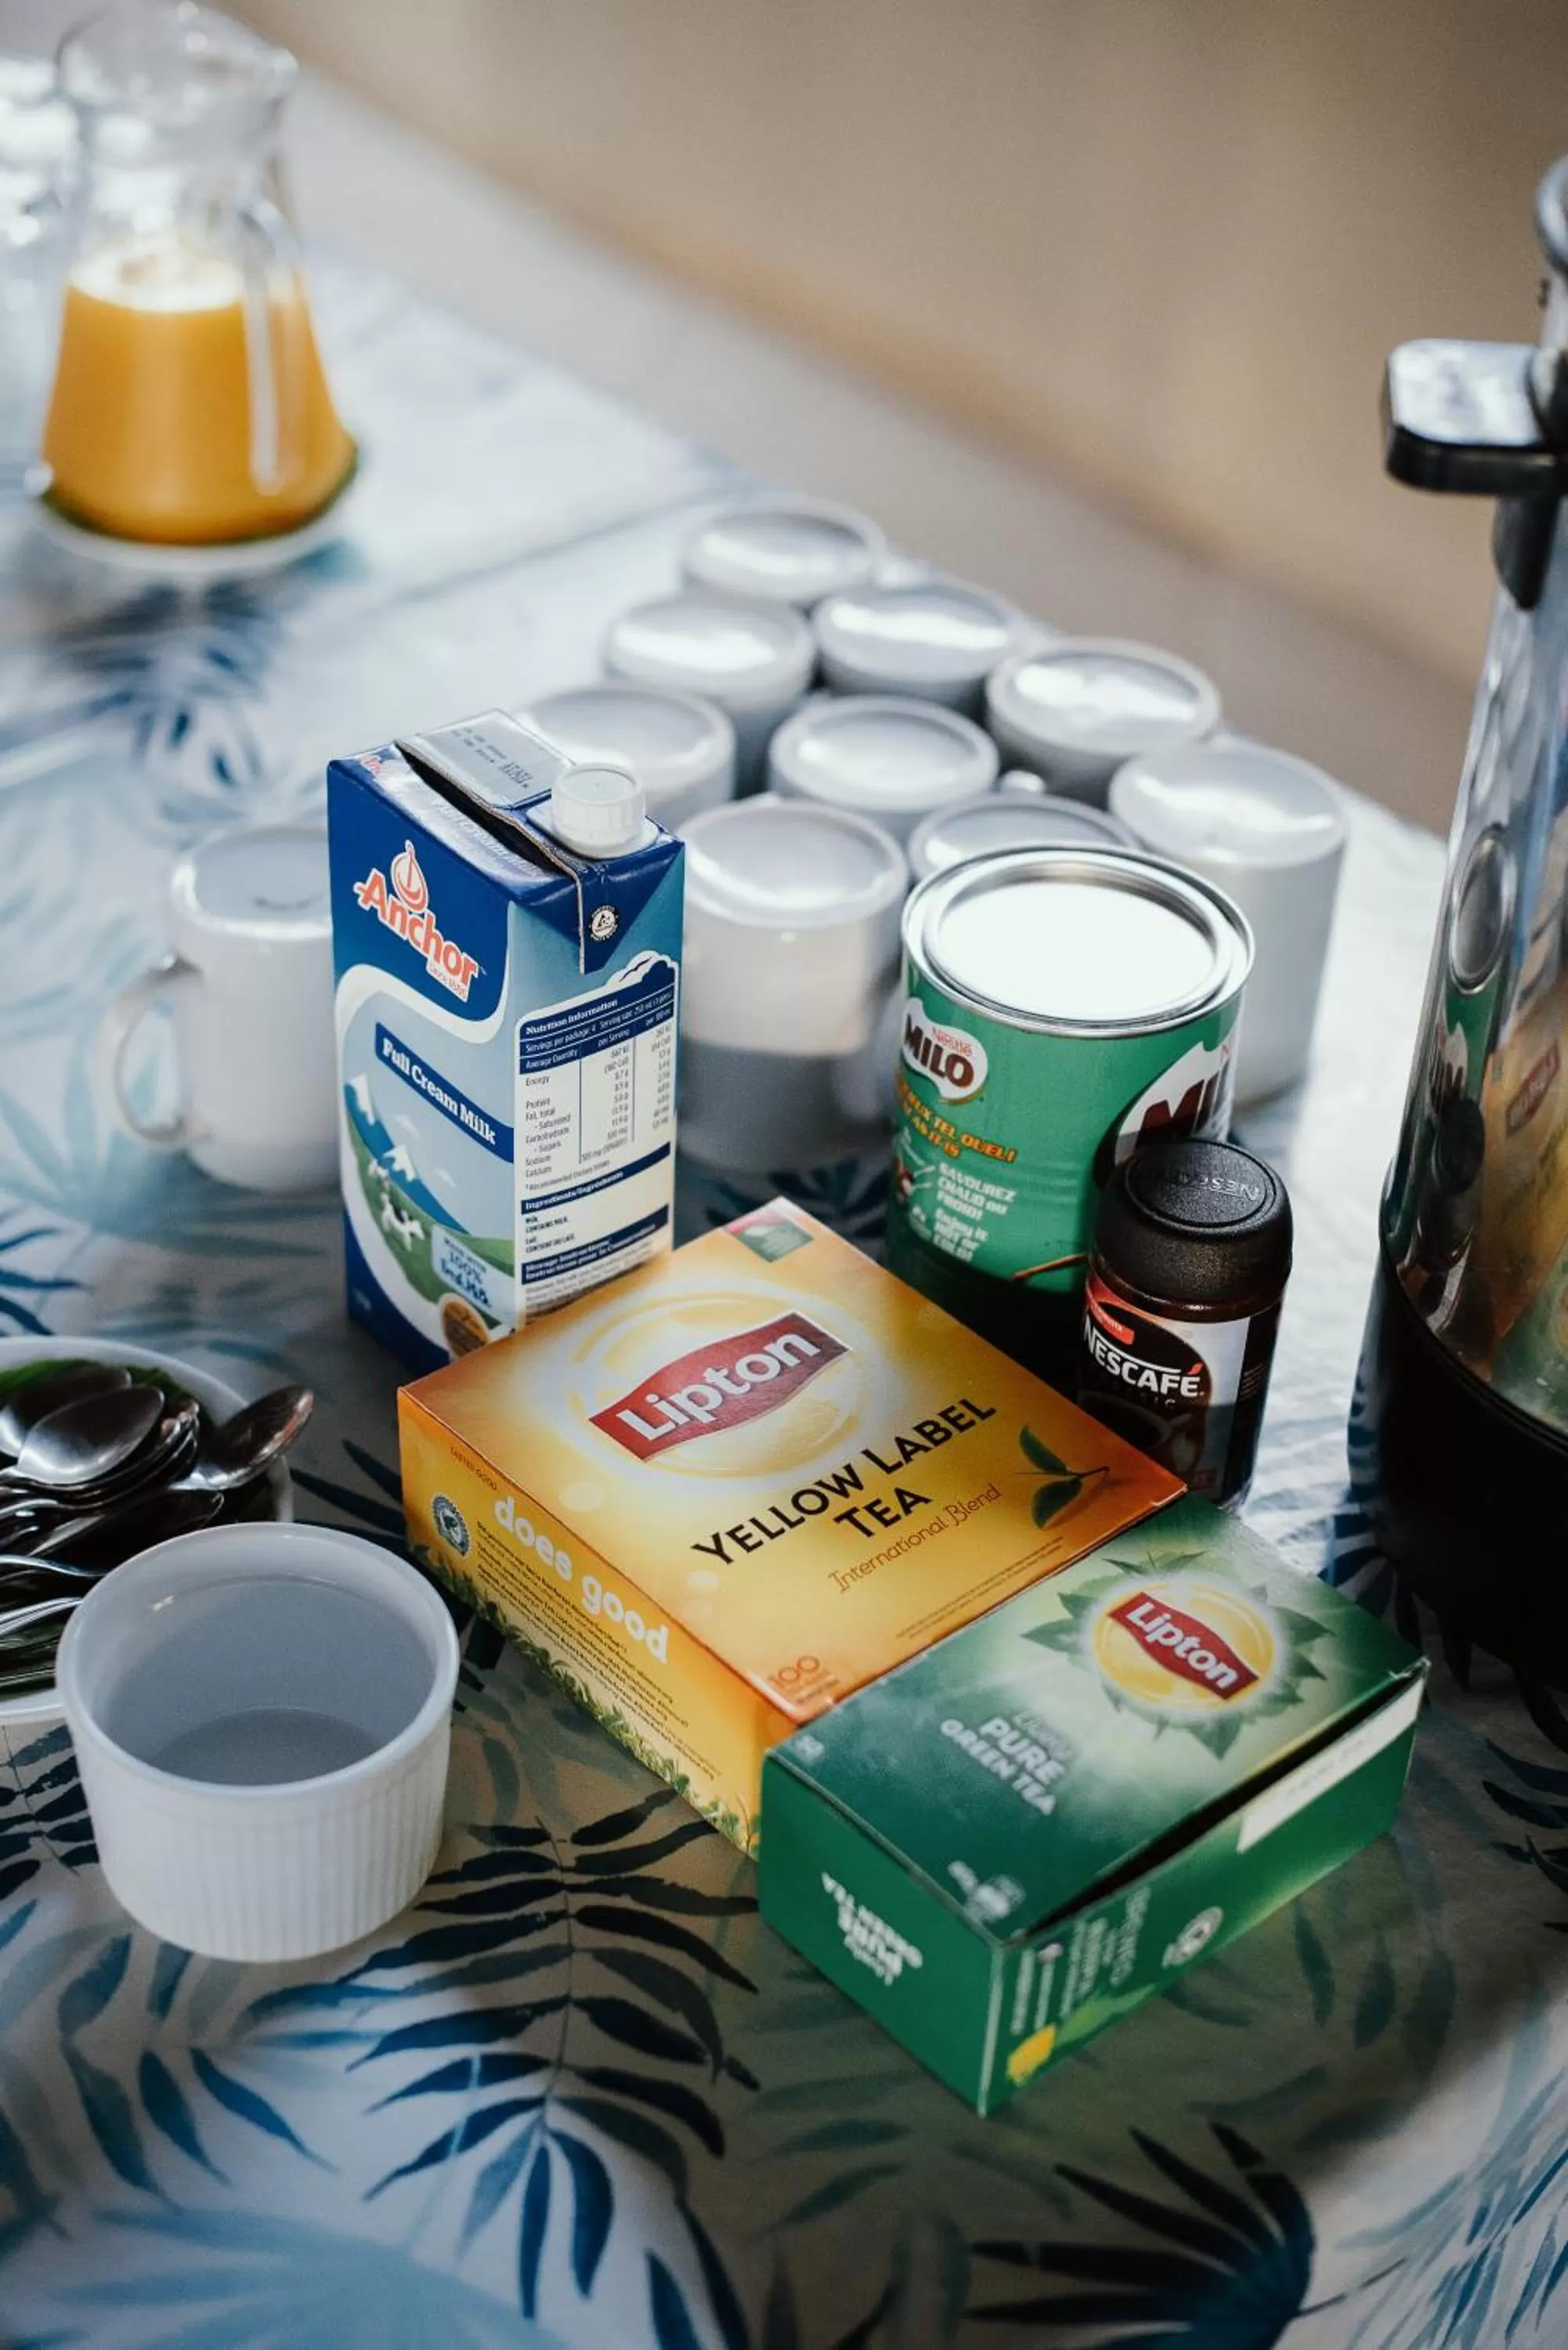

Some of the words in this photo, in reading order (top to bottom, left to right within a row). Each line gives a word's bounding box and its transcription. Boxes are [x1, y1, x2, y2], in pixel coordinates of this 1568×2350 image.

[355, 871, 478, 984] Anchor
[568, 1000, 618, 1025] Information
[905, 1014, 974, 1088] MILO
[381, 1037, 410, 1076] Full
[410, 1064, 457, 1115] Cream
[459, 1104, 497, 1147] Milk
[616, 1331, 820, 1441] Lipton
[691, 1463, 865, 1567] YELLOW
[862, 1397, 998, 1475] LABEL
[833, 1485, 934, 1539] TEA
[493, 1495, 573, 1582] does
[581, 1573, 670, 1665] good
[828, 1515, 948, 1595] International
[945, 1483, 1003, 1528] Blend
[1126, 1600, 1240, 1690] Lipton
[983, 1716, 1066, 1784] PURE
